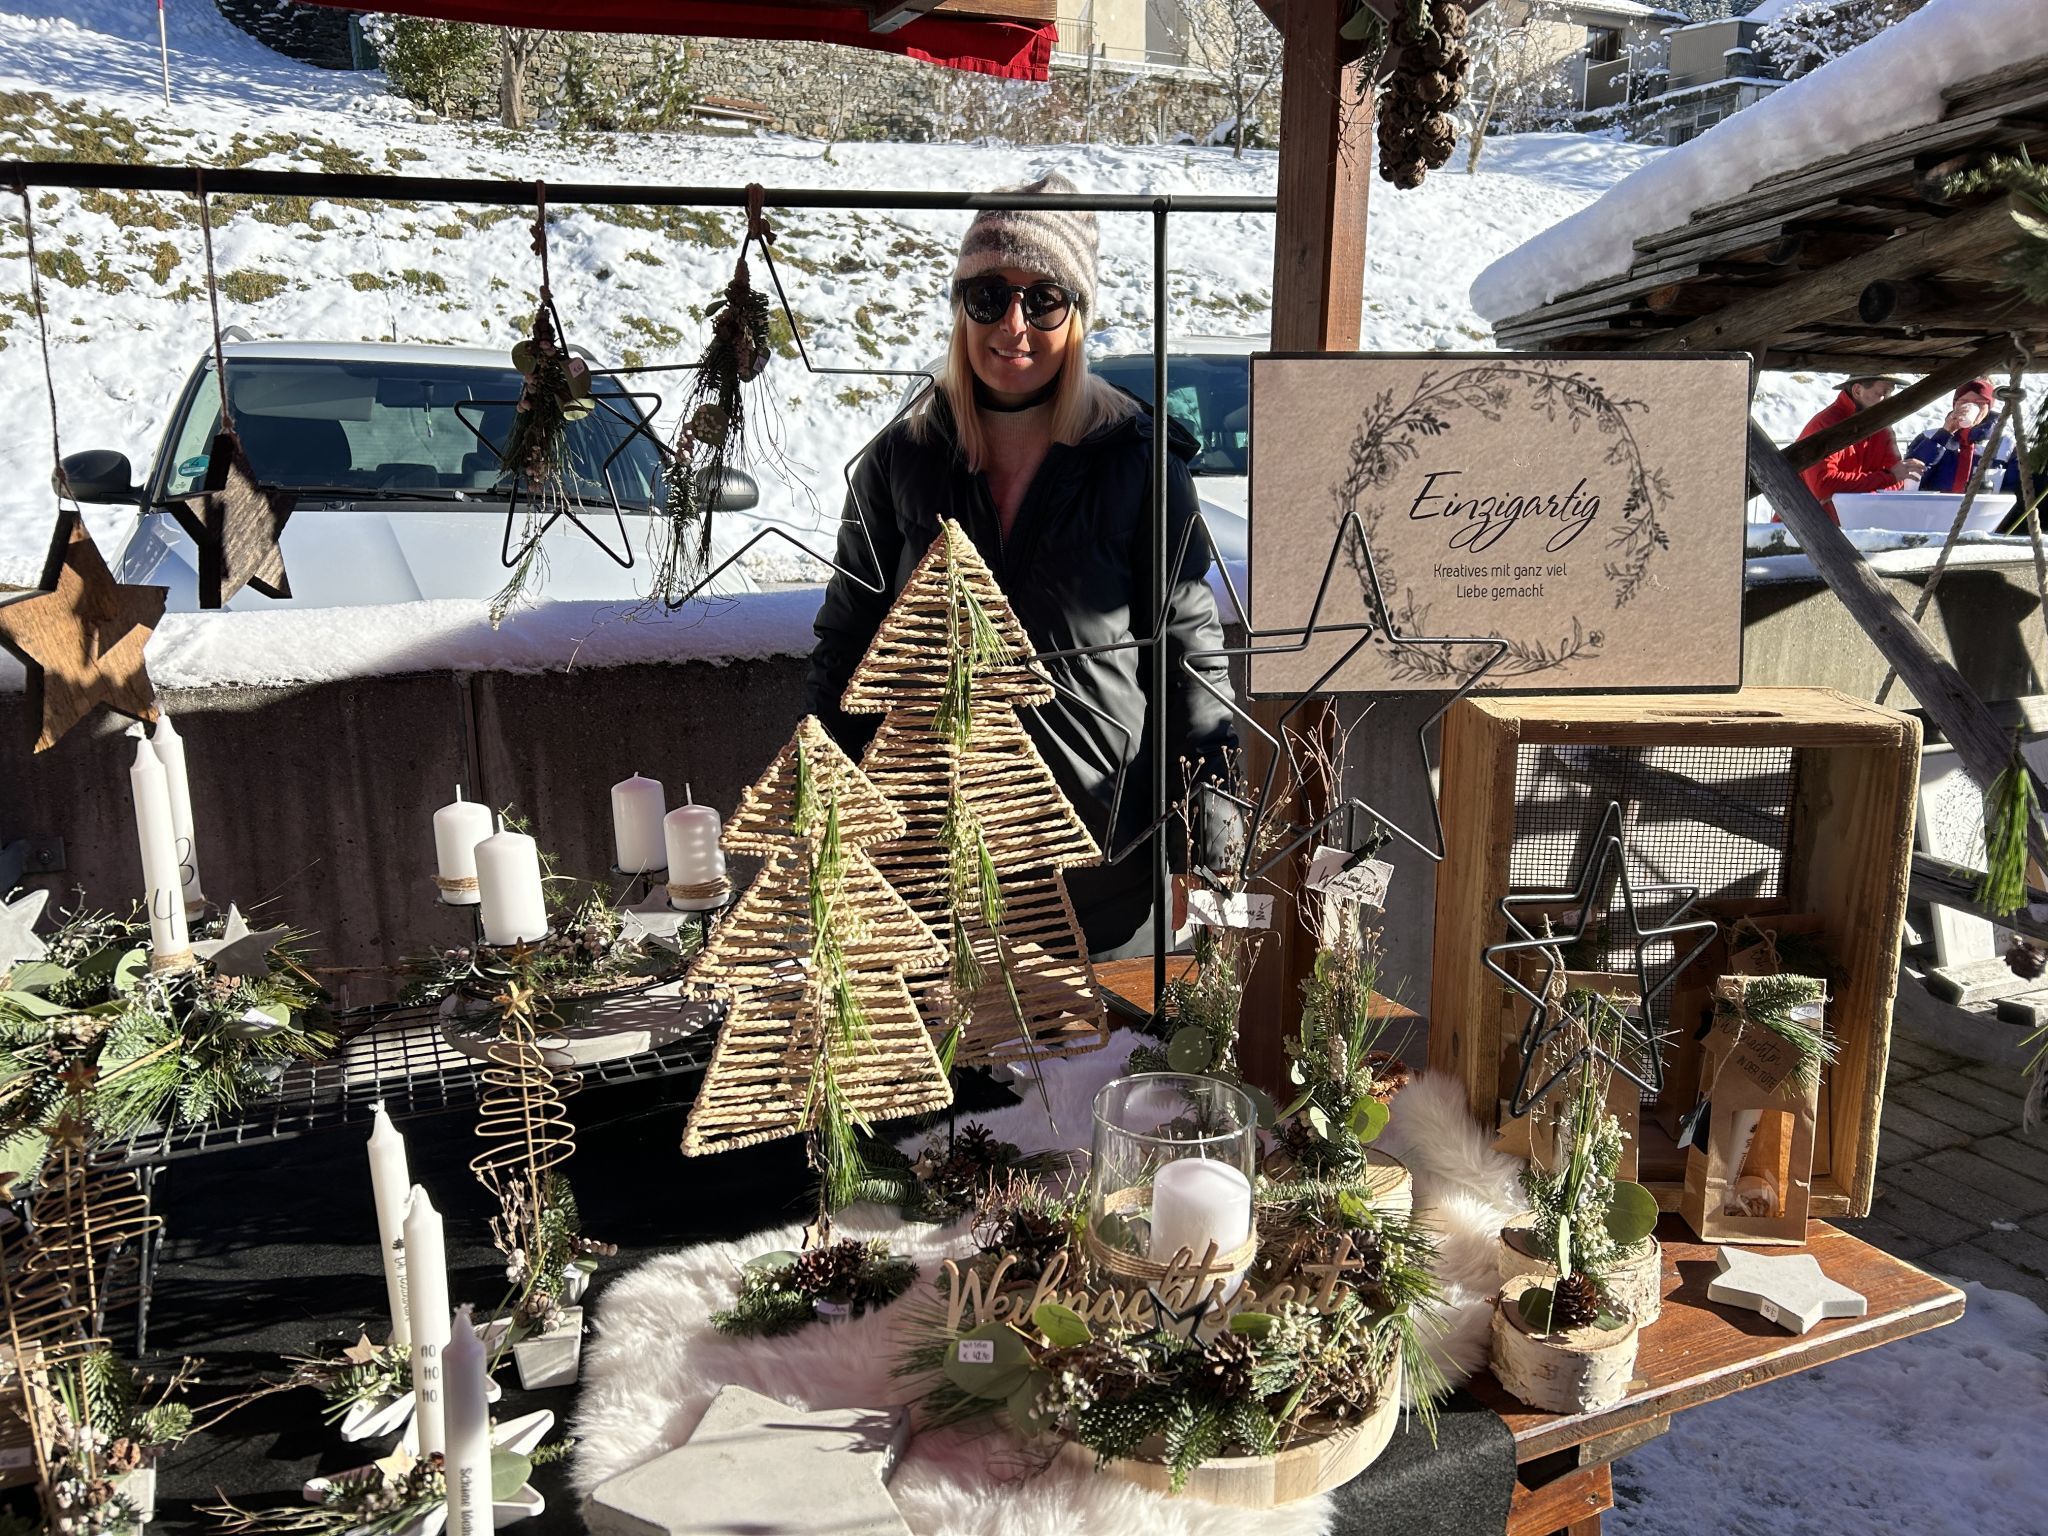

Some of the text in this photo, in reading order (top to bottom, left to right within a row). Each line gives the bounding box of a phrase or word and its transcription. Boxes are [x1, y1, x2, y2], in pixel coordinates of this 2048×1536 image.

[1408, 470, 1602, 553] Einzigartig
[1433, 562, 1568, 579] Kreatives mit ganz viel
[1456, 583, 1544, 600] Liebe gemacht
[153, 888, 177, 940] 4
